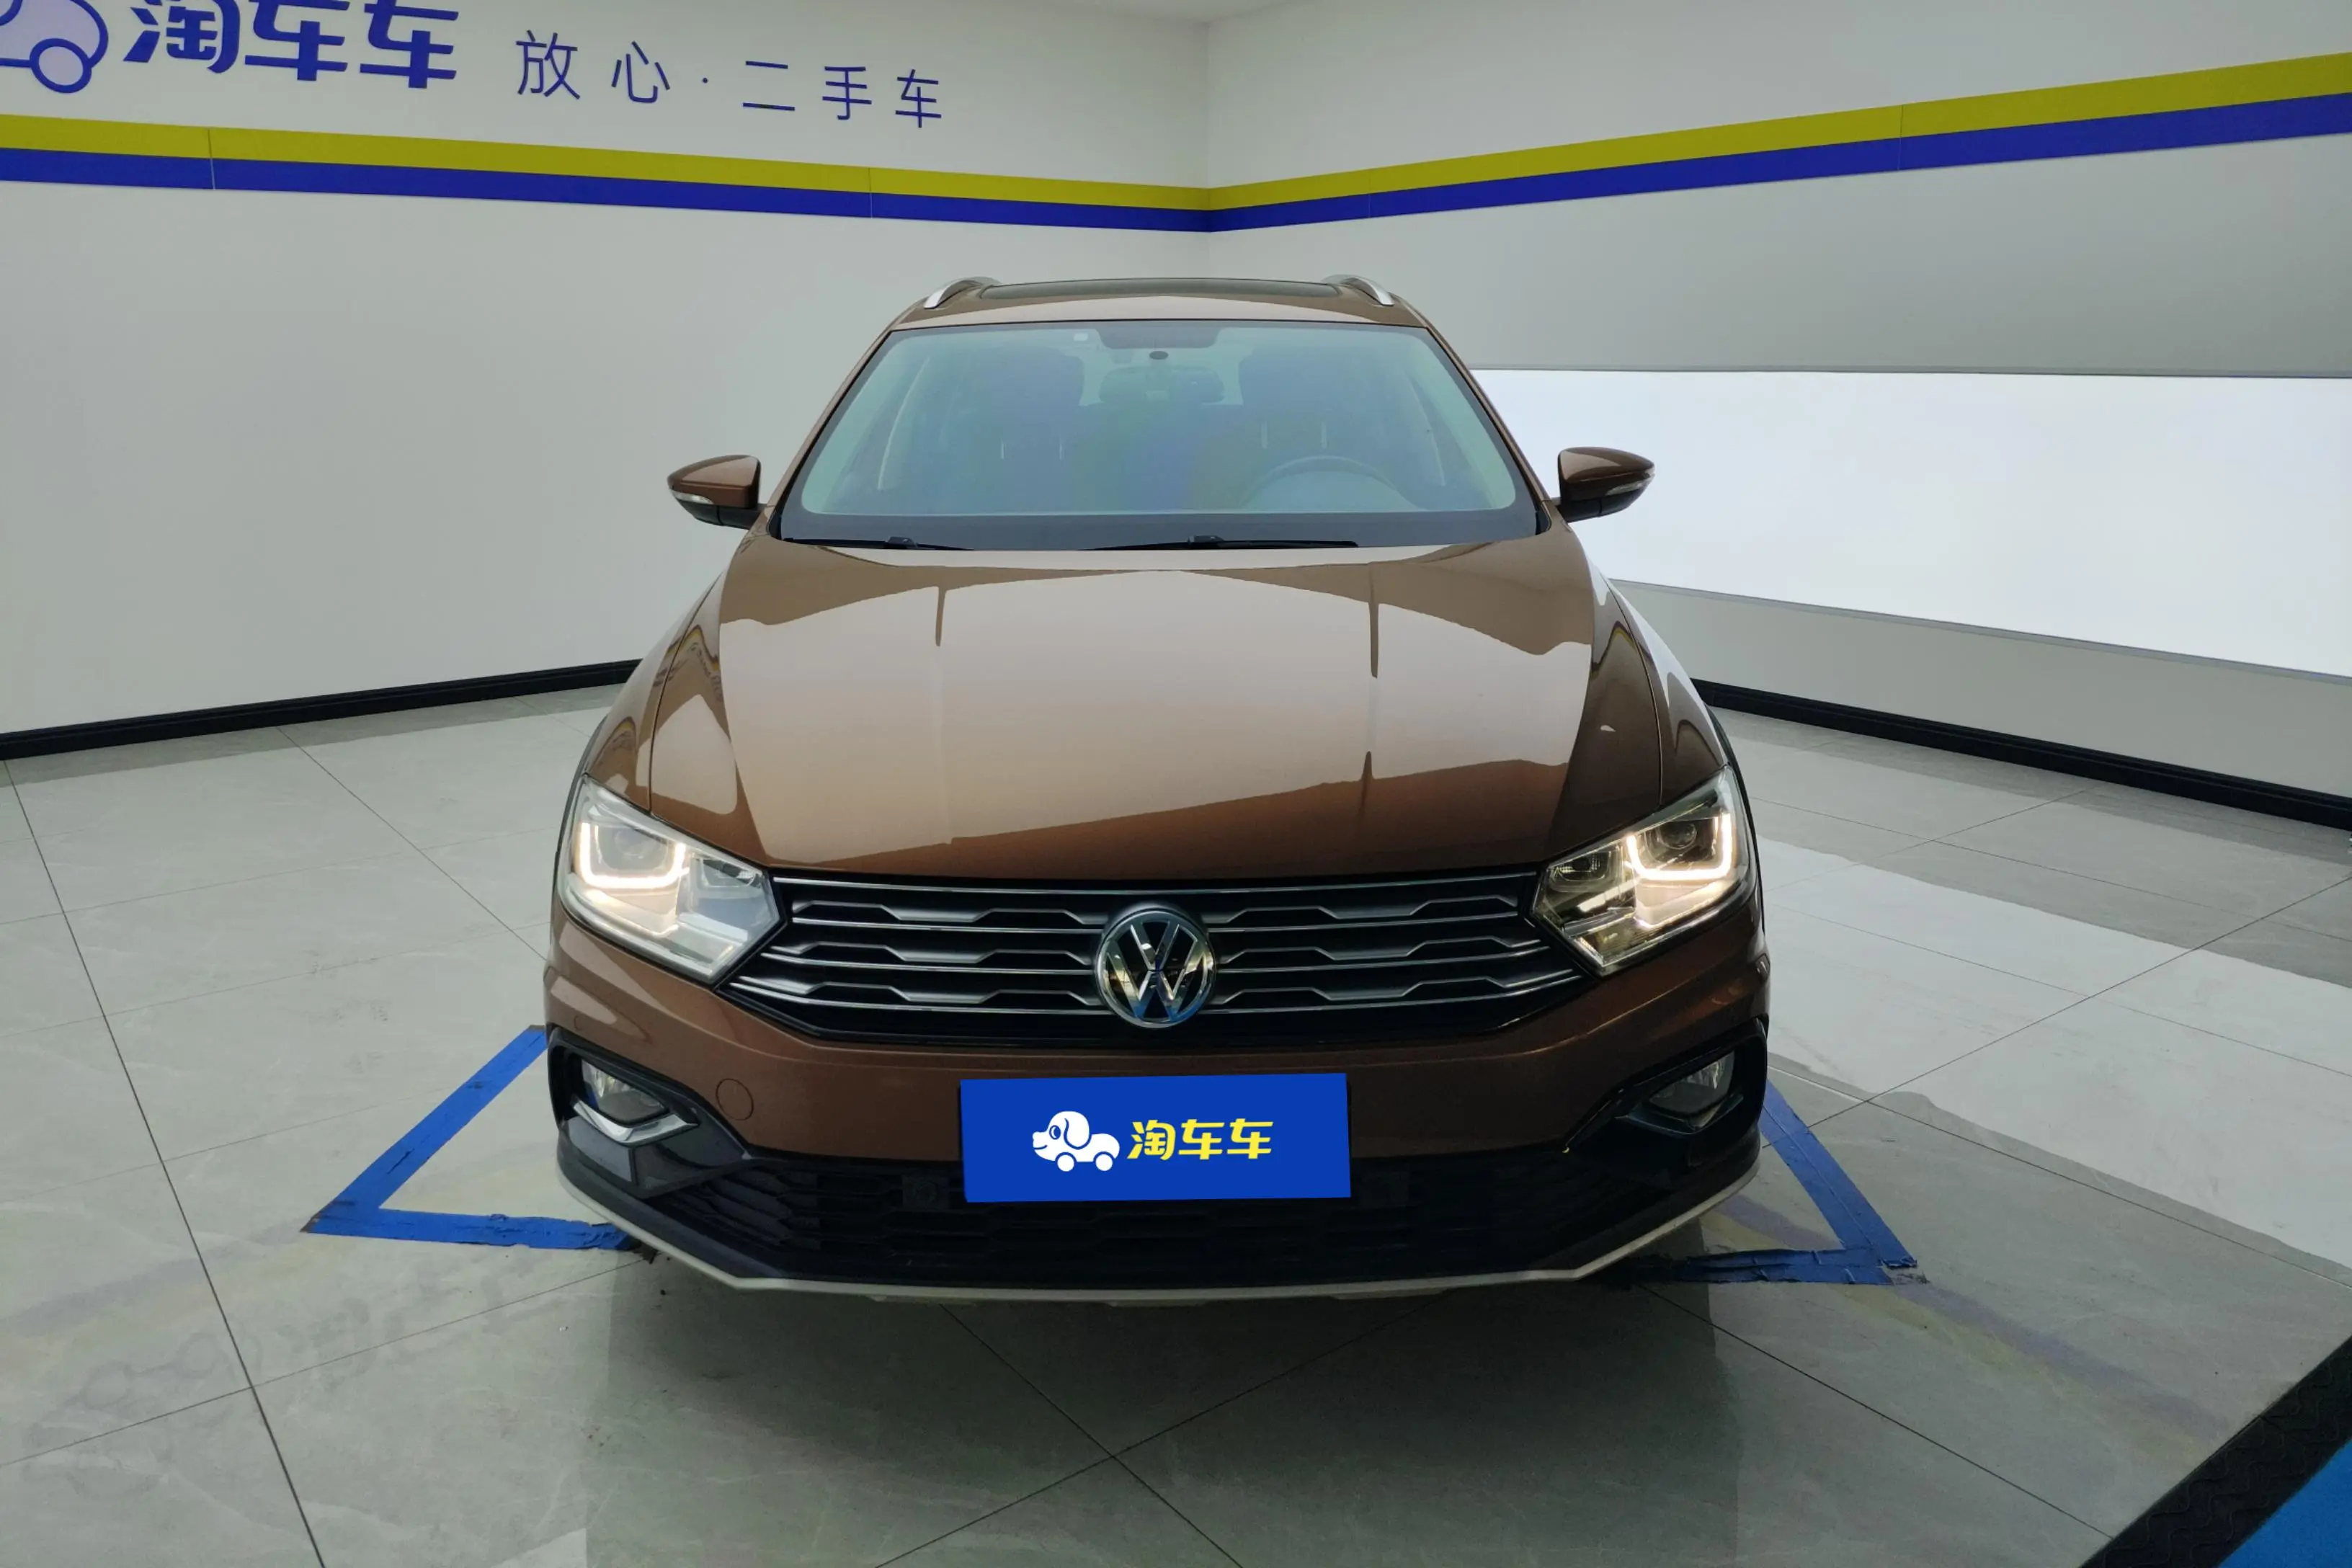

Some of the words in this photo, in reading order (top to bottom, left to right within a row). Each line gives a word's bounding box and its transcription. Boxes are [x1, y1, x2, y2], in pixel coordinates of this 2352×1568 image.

[123, 0, 458, 89] 淘车车
[1097, 905, 1215, 1028] VW
